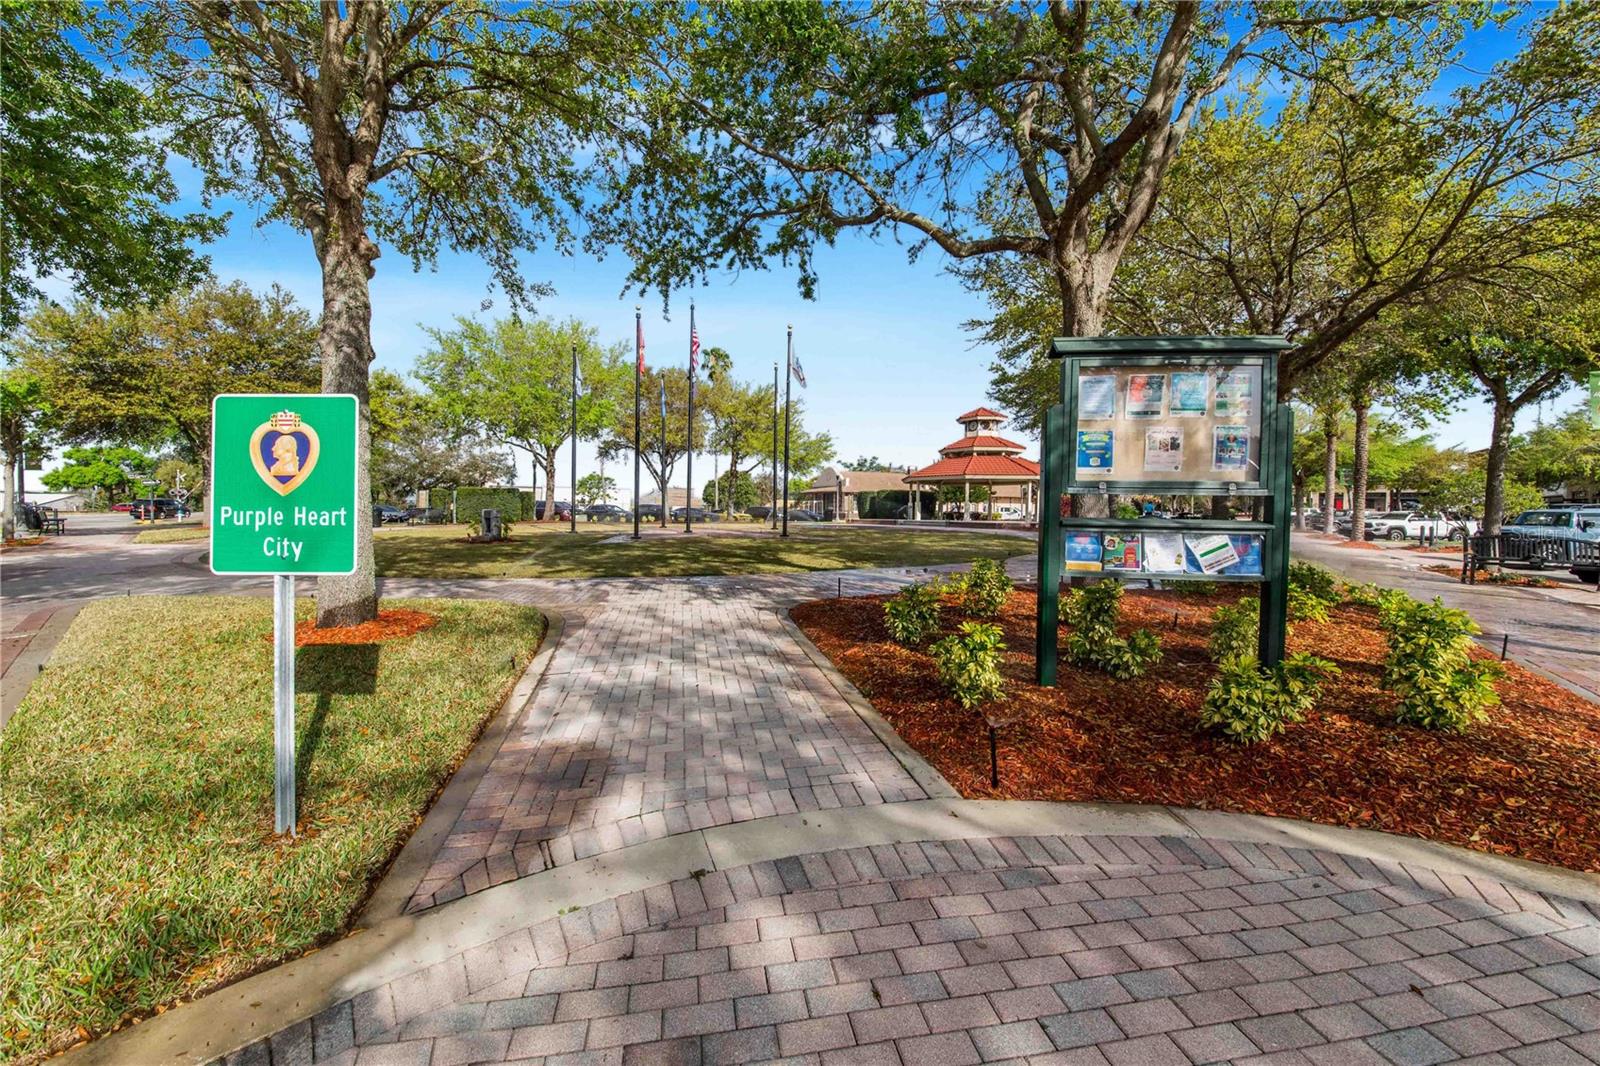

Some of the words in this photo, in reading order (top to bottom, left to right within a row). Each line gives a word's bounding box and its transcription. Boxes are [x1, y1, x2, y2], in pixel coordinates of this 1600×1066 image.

[220, 506, 284, 532] Purple
[294, 506, 346, 526] Heart
[263, 536, 303, 562] City
